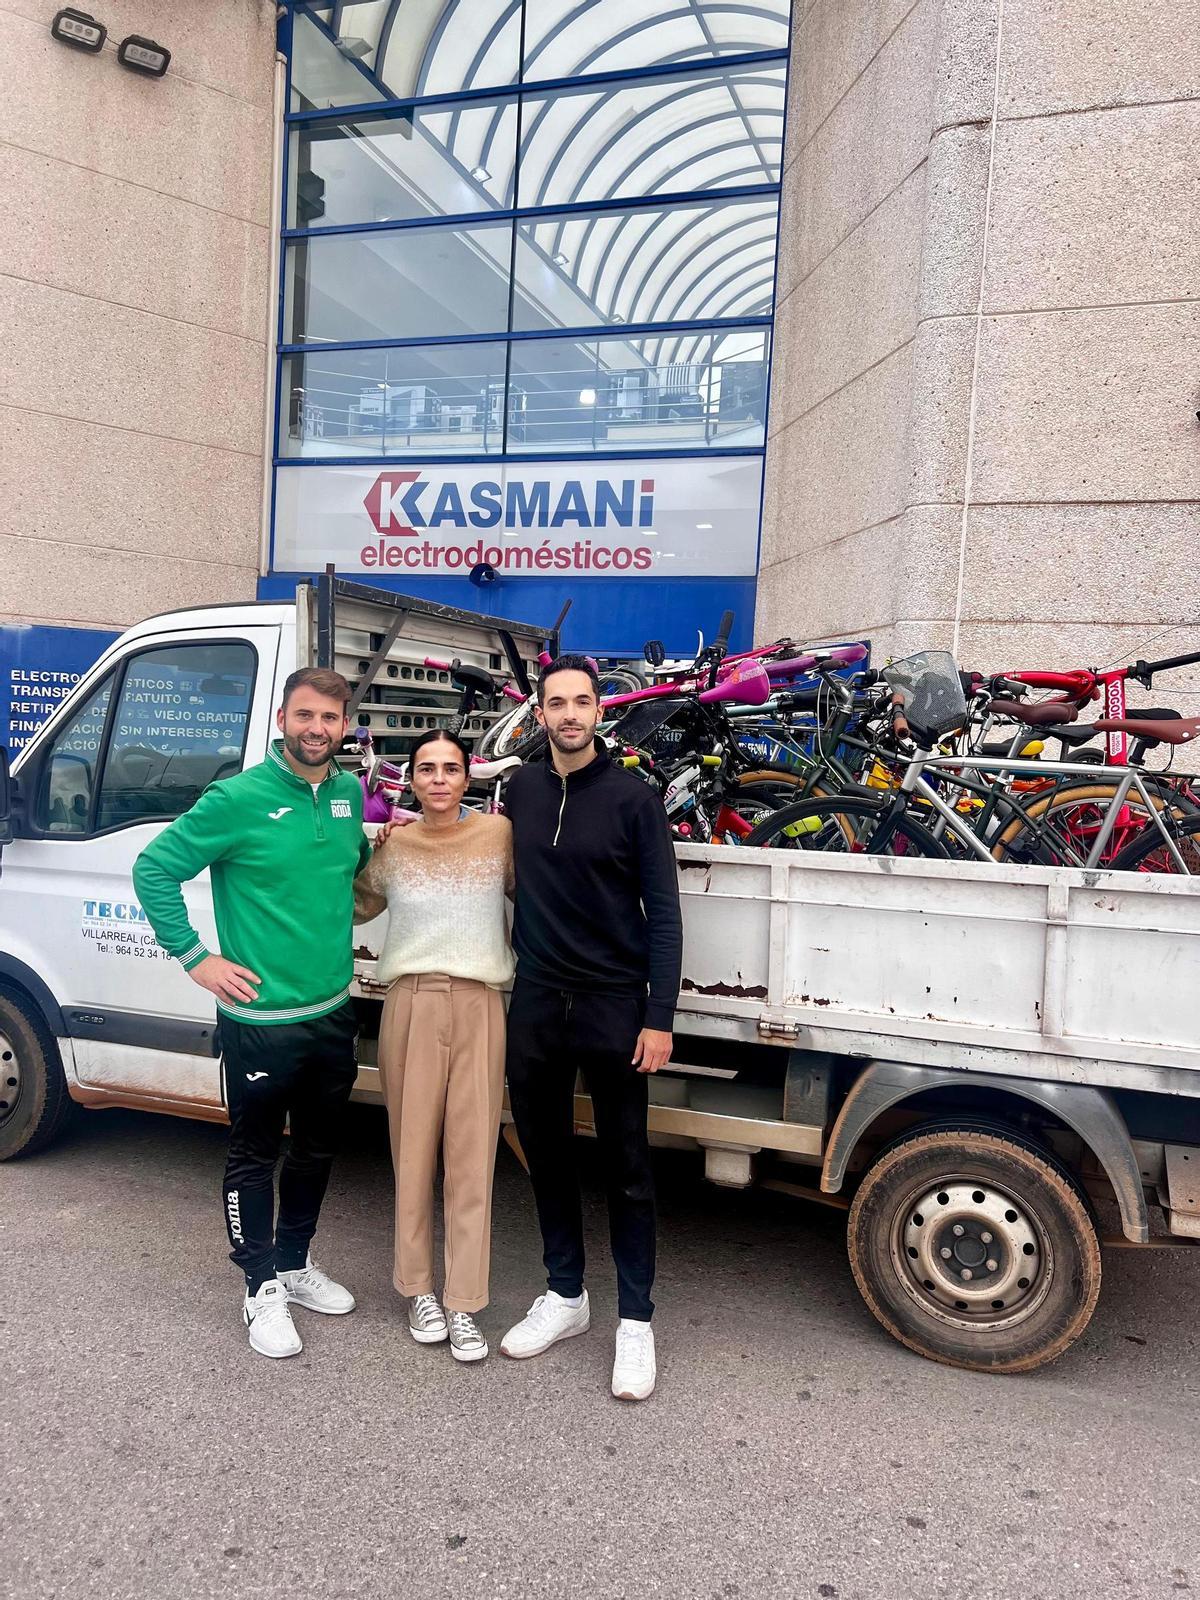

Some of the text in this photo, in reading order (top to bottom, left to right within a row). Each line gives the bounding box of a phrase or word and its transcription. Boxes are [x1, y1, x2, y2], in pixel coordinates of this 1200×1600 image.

[360, 540, 652, 569] electrodomésticos
[11, 670, 174, 690] ELECTRO STICOS
[11, 685, 71, 699] TRANSP
[10, 702, 55, 714] RETIR
[154, 710, 192, 721] VIEJO
[196, 712, 248, 723] GRATUIT
[9, 720, 43, 732] FINA
[120, 725, 142, 736] SIN
[147, 727, 219, 739] INTERESES
[9, 737, 31, 748] INS
[330, 804, 352, 818] RODA
[84, 901, 147, 921] TECM
[82, 928, 160, 946] VILLARREAL (Ca
[116, 945, 131, 955] 964
[134, 947, 145, 957] 52
[147, 949, 158, 958] 34
